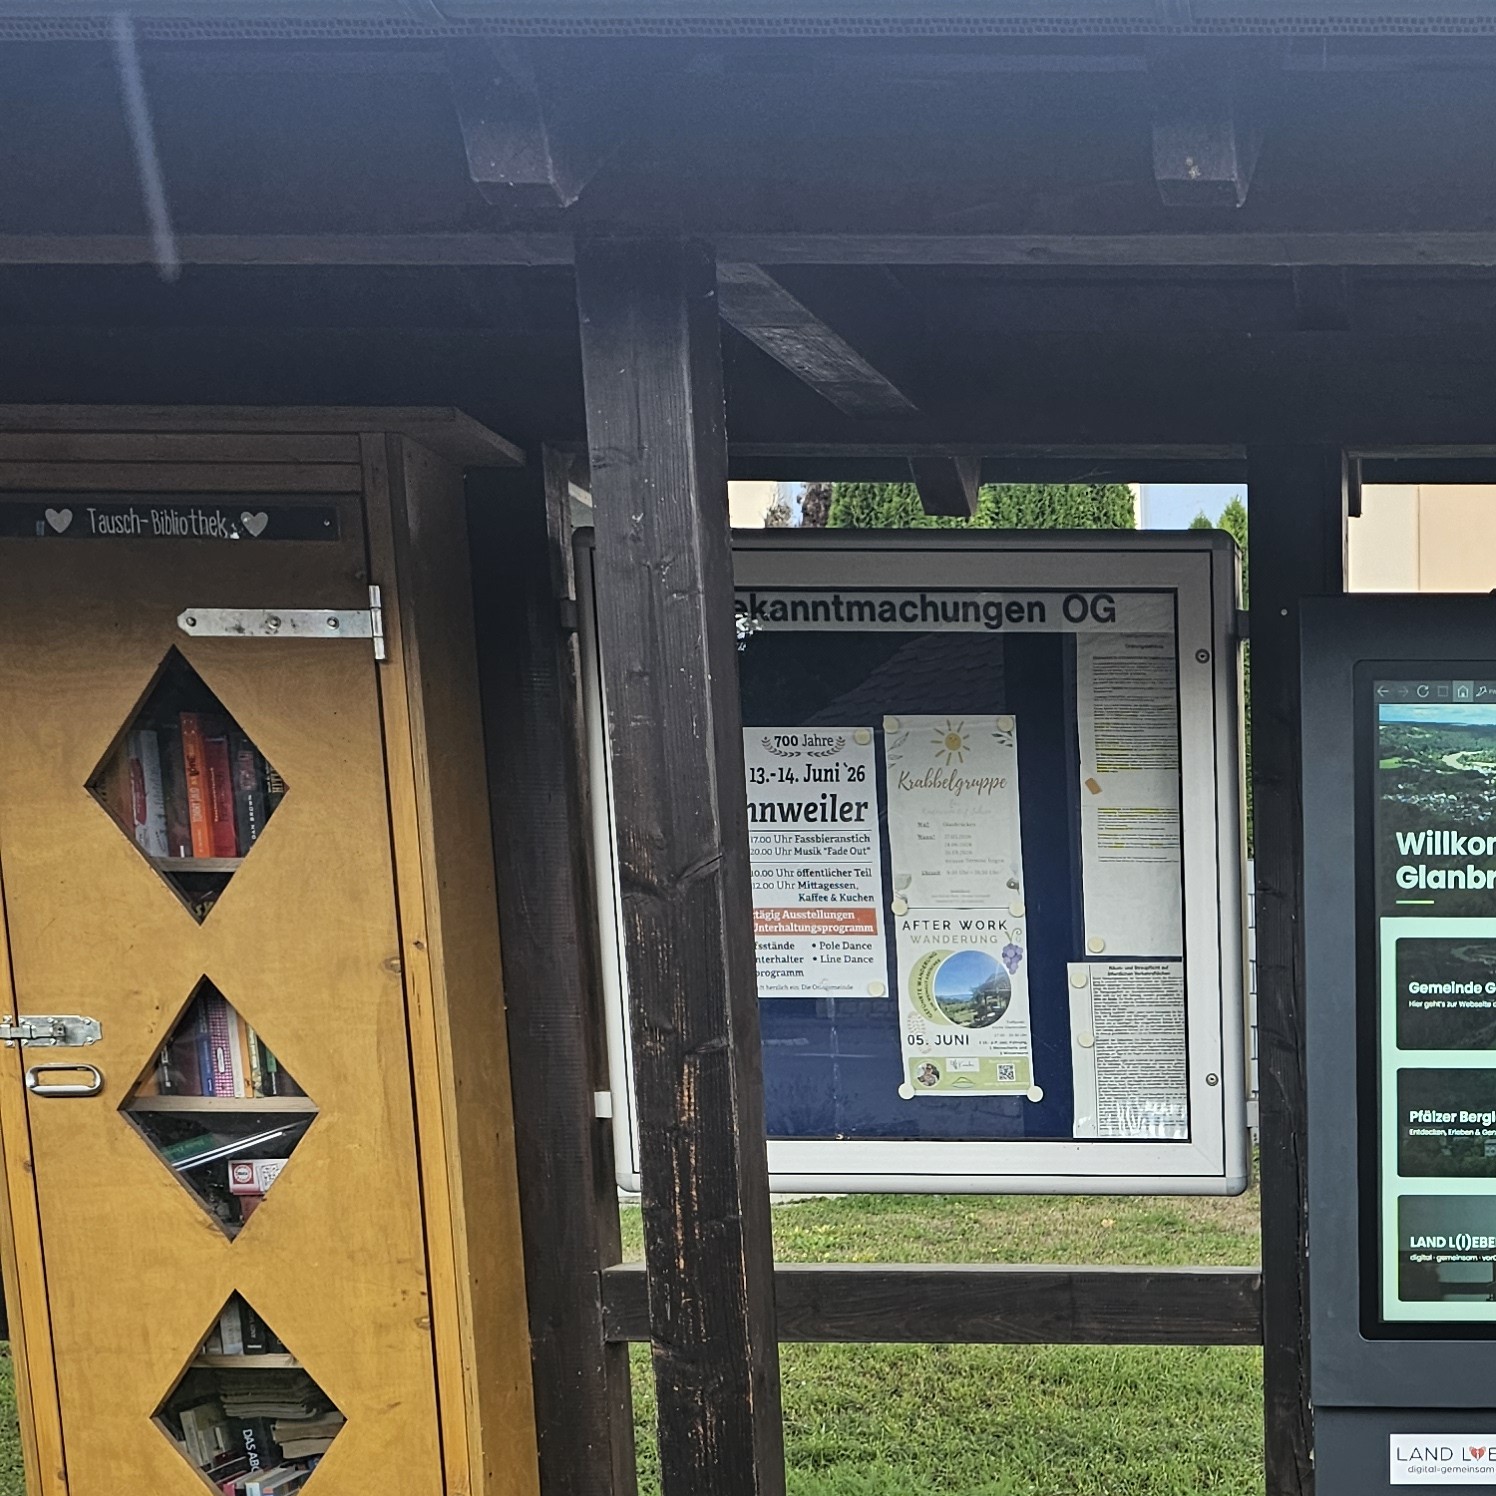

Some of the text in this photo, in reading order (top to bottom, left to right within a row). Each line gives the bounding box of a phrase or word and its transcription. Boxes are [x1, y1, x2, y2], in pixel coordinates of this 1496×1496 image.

[1062, 593, 1116, 623] OG
[774, 733, 834, 748] 700 Jahre
[803, 761, 841, 783] Juni
[898, 767, 1008, 797] Krabbelgruppe
[247, 794, 255, 822] BROWN
[774, 835, 792, 844] Uhr
[795, 834, 871, 844] Fassbieranstich
[750, 848, 773, 856] 20.00
[775, 847, 792, 855] Uhr
[794, 847, 822, 855] Musik
[823, 847, 848, 855] "Fade
[776, 869, 794, 877] Uhr
[797, 868, 852, 877] öffentlicher
[854, 868, 873, 877] Teil
[777, 881, 795, 890] Uhr
[798, 881, 859, 891] Mittagessen,
[798, 893, 875, 902] Kaffee & Kuchen
[782, 909, 855, 922] Ausstellungen
[902, 919, 1008, 931] AFTER WORK
[819, 941, 841, 950] Pole
[842, 941, 873, 950] Dance
[910, 935, 998, 944] WANDERUNG
[820, 954, 842, 963] Line
[844, 955, 874, 963] Dance
[1408, 981, 1482, 995] Gemeinde
[1408, 1000, 1423, 1008] Hier
[1459, 1000, 1492, 1008] Webseite
[907, 1034, 929, 1046] 05.
[934, 1034, 969, 1046] JUNI
[1409, 1110, 1457, 1124] Pfälzer
[1410, 1236, 1446, 1249] LAND
[1410, 1254, 1432, 1263] digital
[1436, 1255, 1478, 1263] gemeinsam
[242, 1428, 257, 1451] DAS
[1396, 1447, 1453, 1462] LAND
